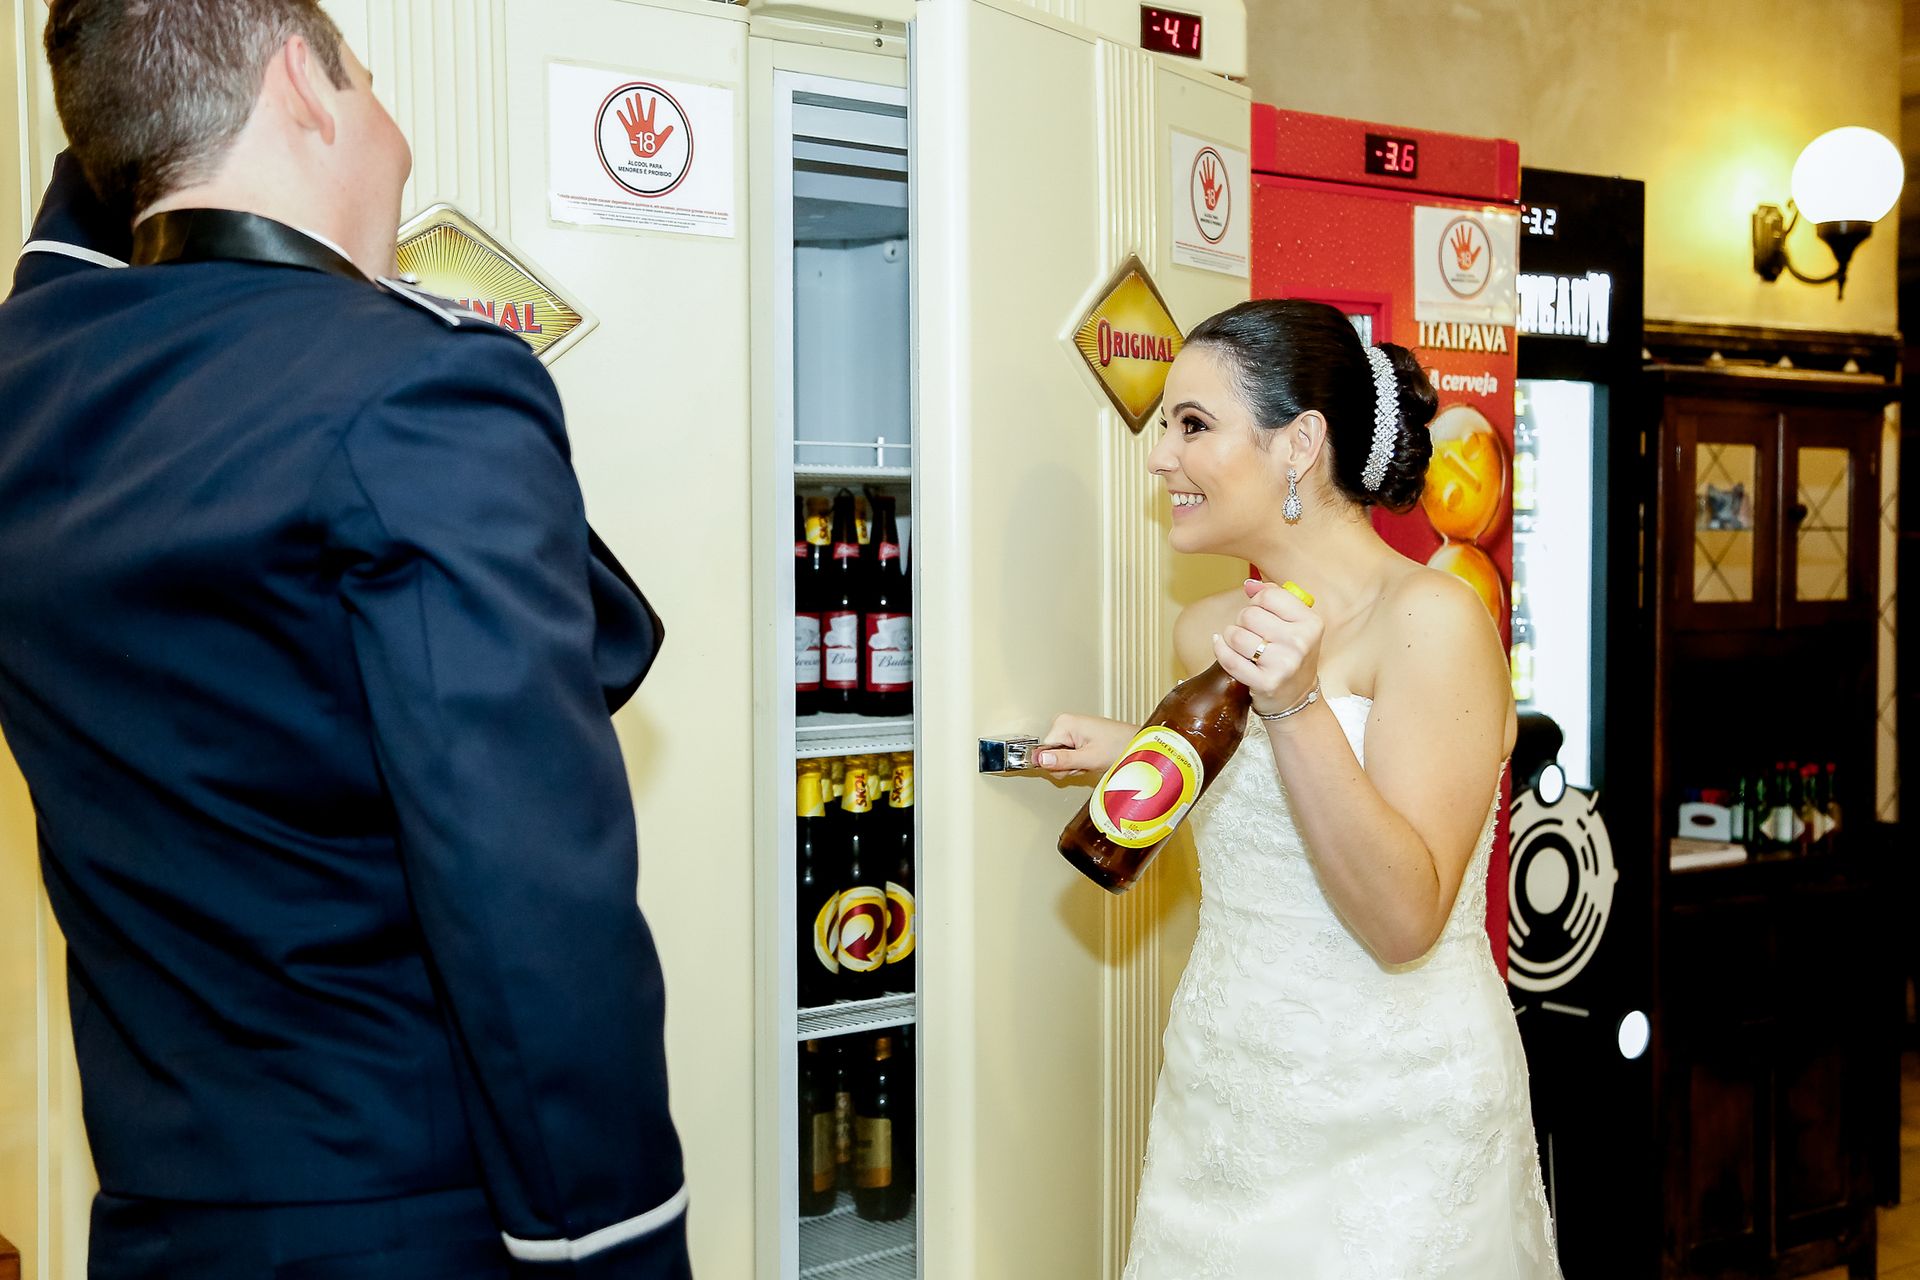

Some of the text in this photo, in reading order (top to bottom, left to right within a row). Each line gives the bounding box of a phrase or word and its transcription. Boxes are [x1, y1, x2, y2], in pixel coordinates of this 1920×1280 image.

[630, 131, 656, 154] -18
[617, 166, 643, 175] MENORES
[648, 169, 673, 178] PROIBIDO
[627, 160, 663, 170] ÁLCOOL PARA
[1097, 318, 1175, 367] ORIGINAL
[1419, 321, 1508, 354] ITAIPAVA
[1441, 371, 1498, 397] cerveja
